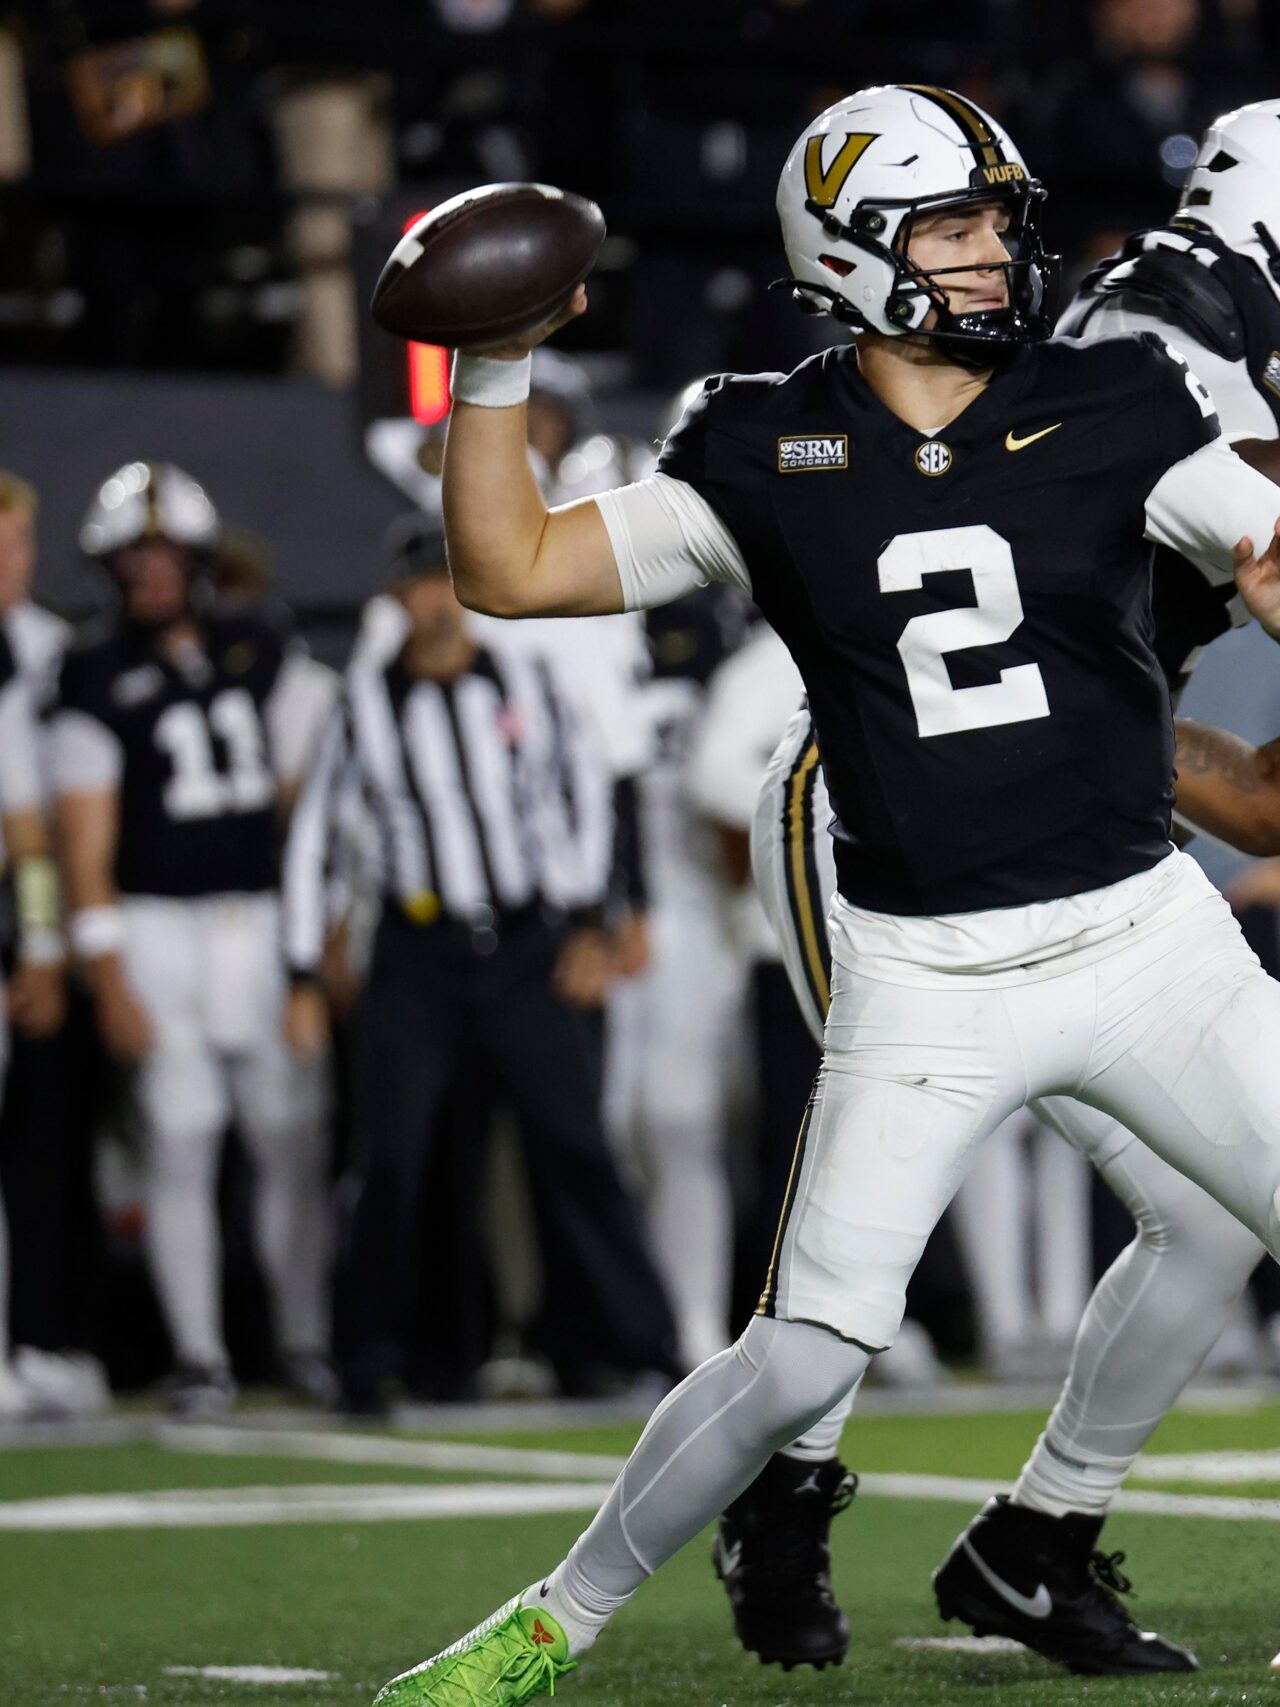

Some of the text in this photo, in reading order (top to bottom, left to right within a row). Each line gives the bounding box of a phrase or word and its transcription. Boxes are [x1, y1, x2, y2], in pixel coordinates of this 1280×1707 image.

[804, 132, 883, 209] V
[982, 164, 1024, 185] VUFB
[781, 457, 845, 468] CONCRETE
[791, 439, 845, 459] SRM
[918, 443, 949, 474] SEC
[877, 523, 1051, 738] 2
[155, 688, 277, 822] 11
